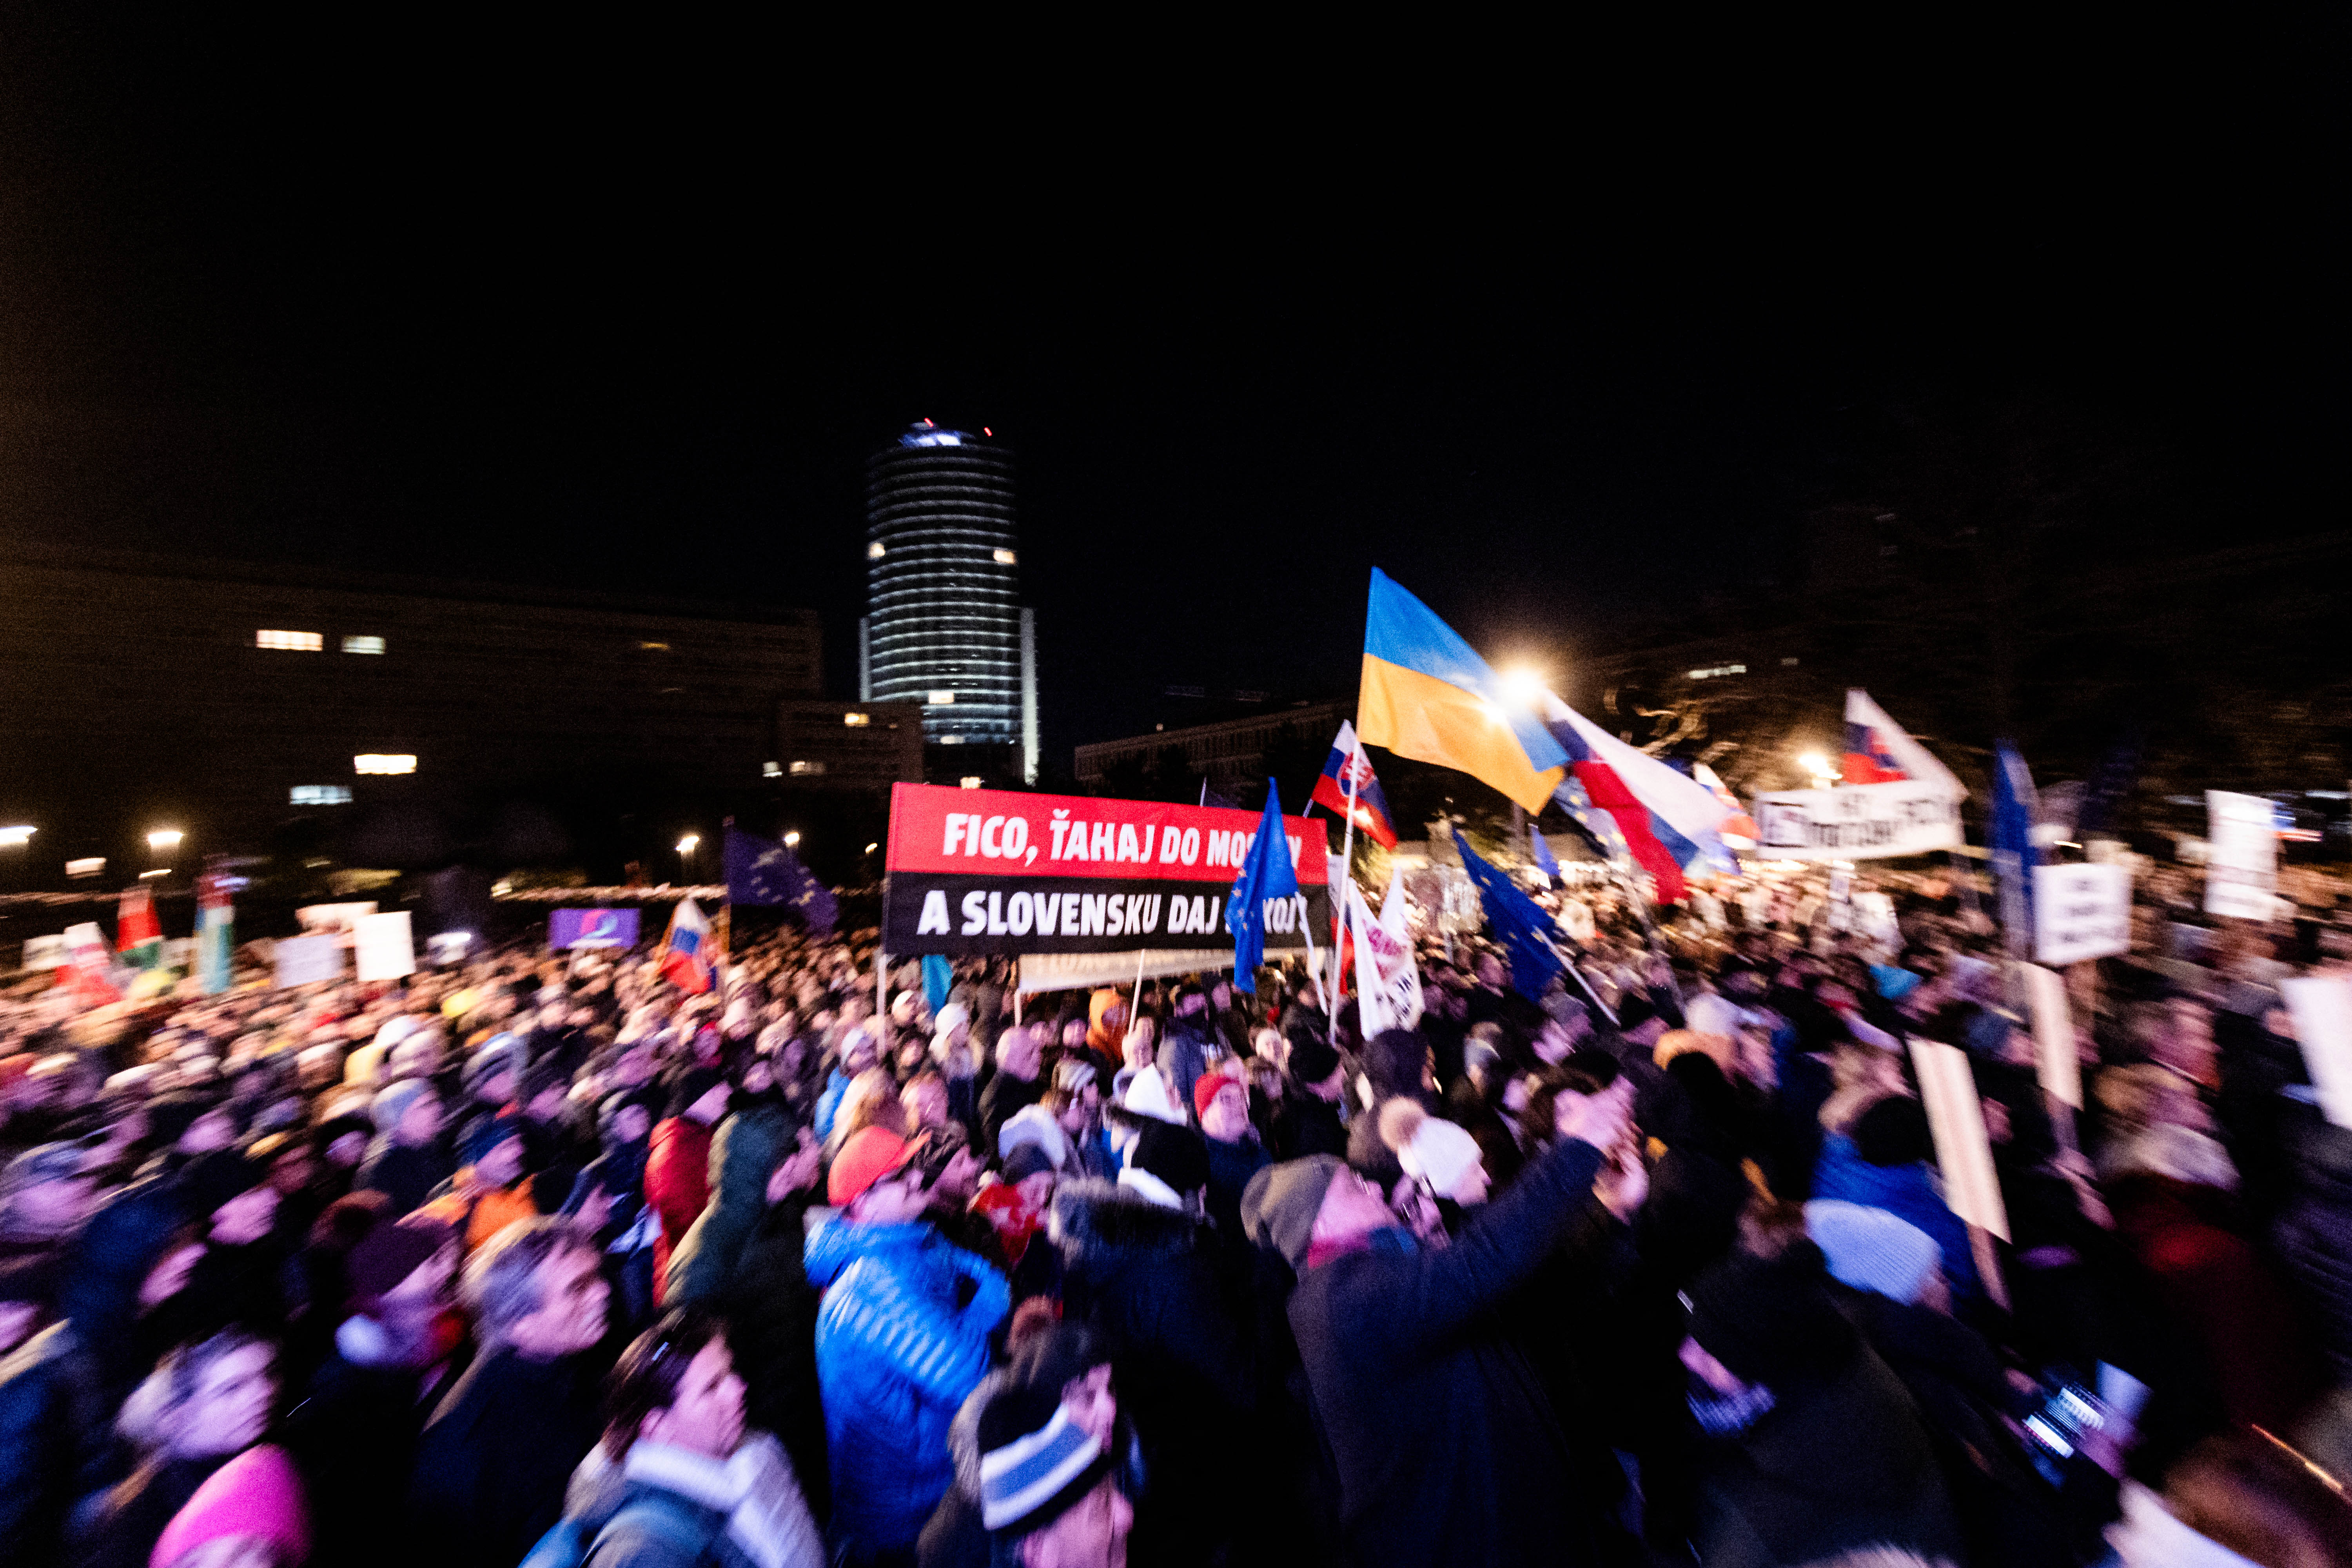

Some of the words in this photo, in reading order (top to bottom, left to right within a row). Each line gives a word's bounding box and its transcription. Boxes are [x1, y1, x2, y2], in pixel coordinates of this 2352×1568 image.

[942, 813, 1038, 867] FICO,
[1049, 808, 1155, 864] ŤAHAJ
[1159, 825, 1200, 866] DO
[916, 890, 951, 935] A
[961, 890, 1161, 936] SLOVENSKU
[1167, 894, 1220, 935] DAJ
